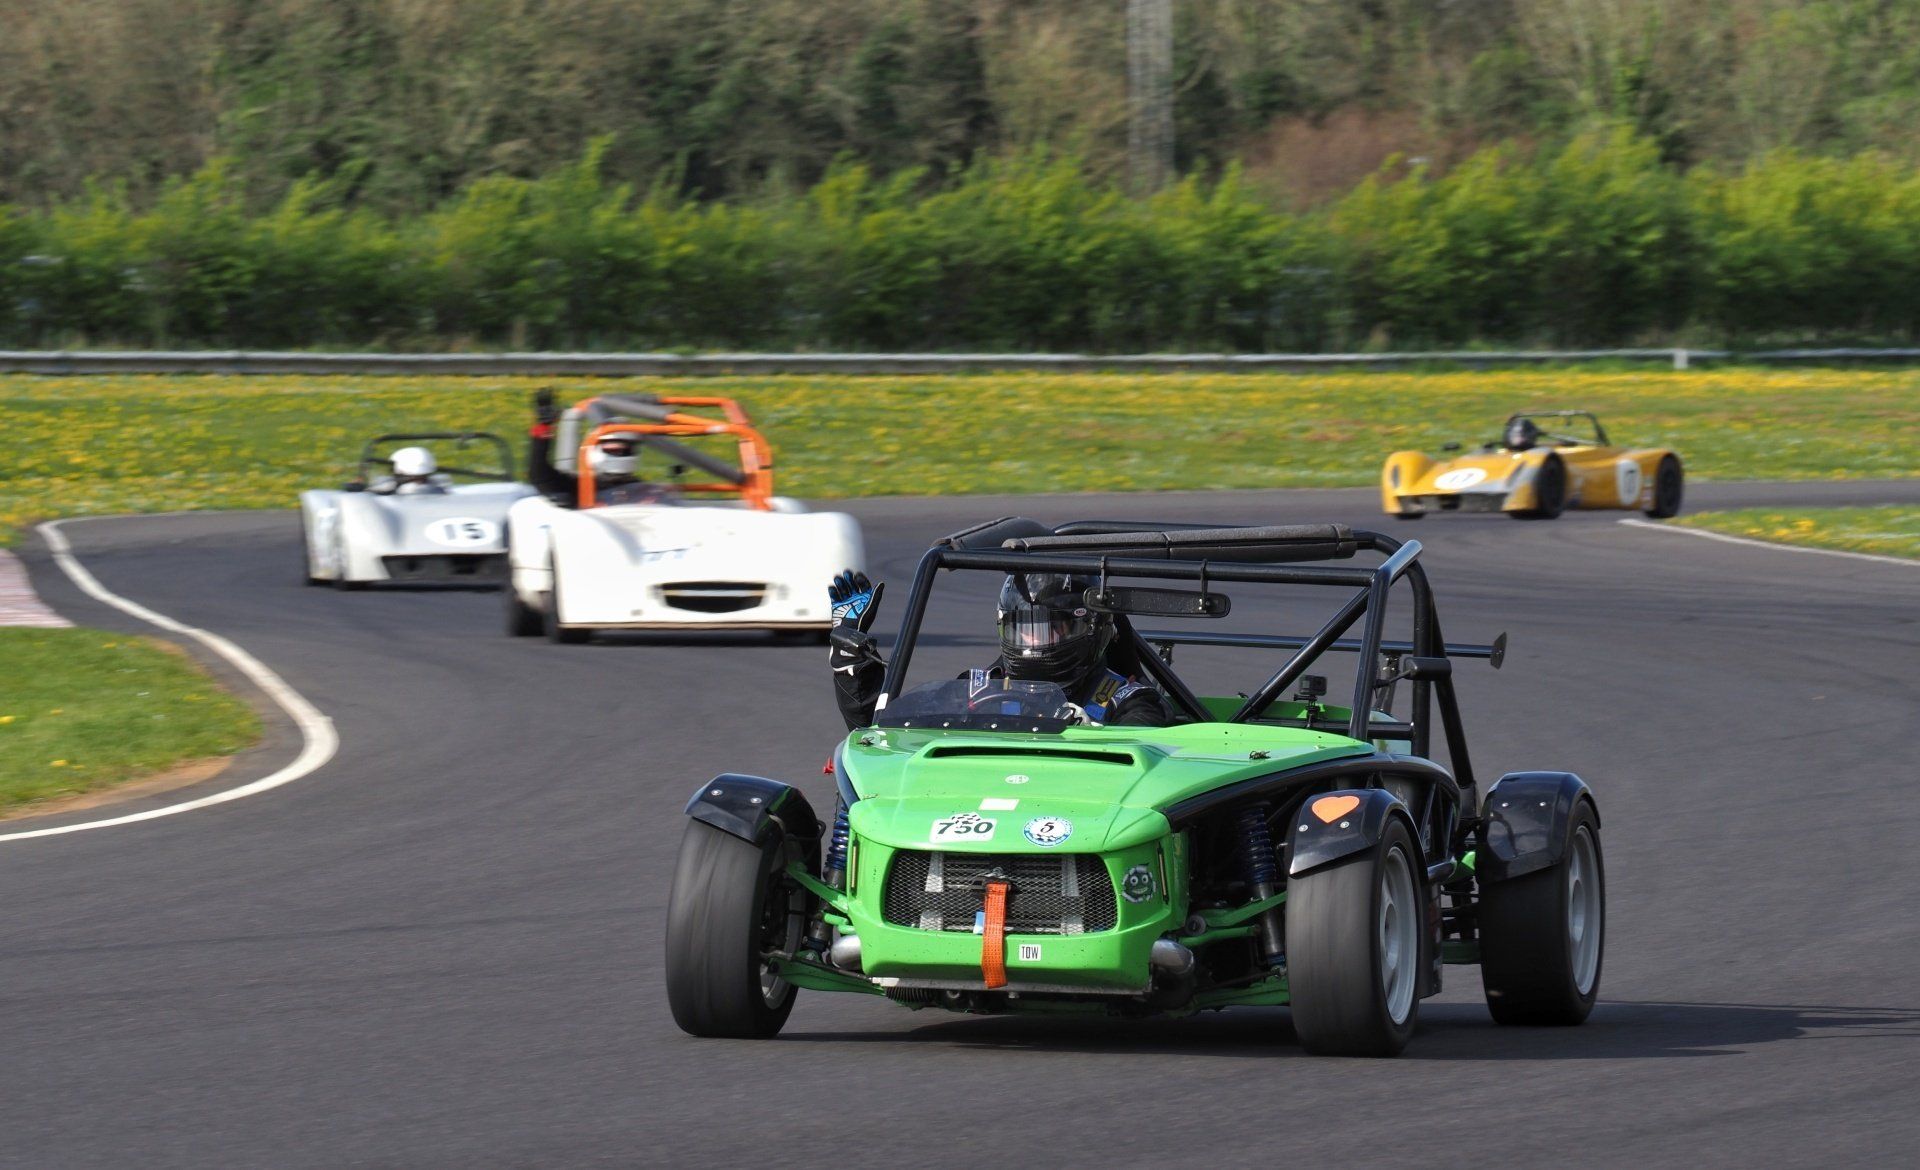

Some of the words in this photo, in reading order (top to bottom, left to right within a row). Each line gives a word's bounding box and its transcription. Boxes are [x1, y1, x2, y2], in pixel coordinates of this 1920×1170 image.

[443, 522, 486, 540] 15
[937, 821, 994, 835] 750
[1040, 821, 1055, 834] 5
[1021, 946, 1039, 959] TOW
